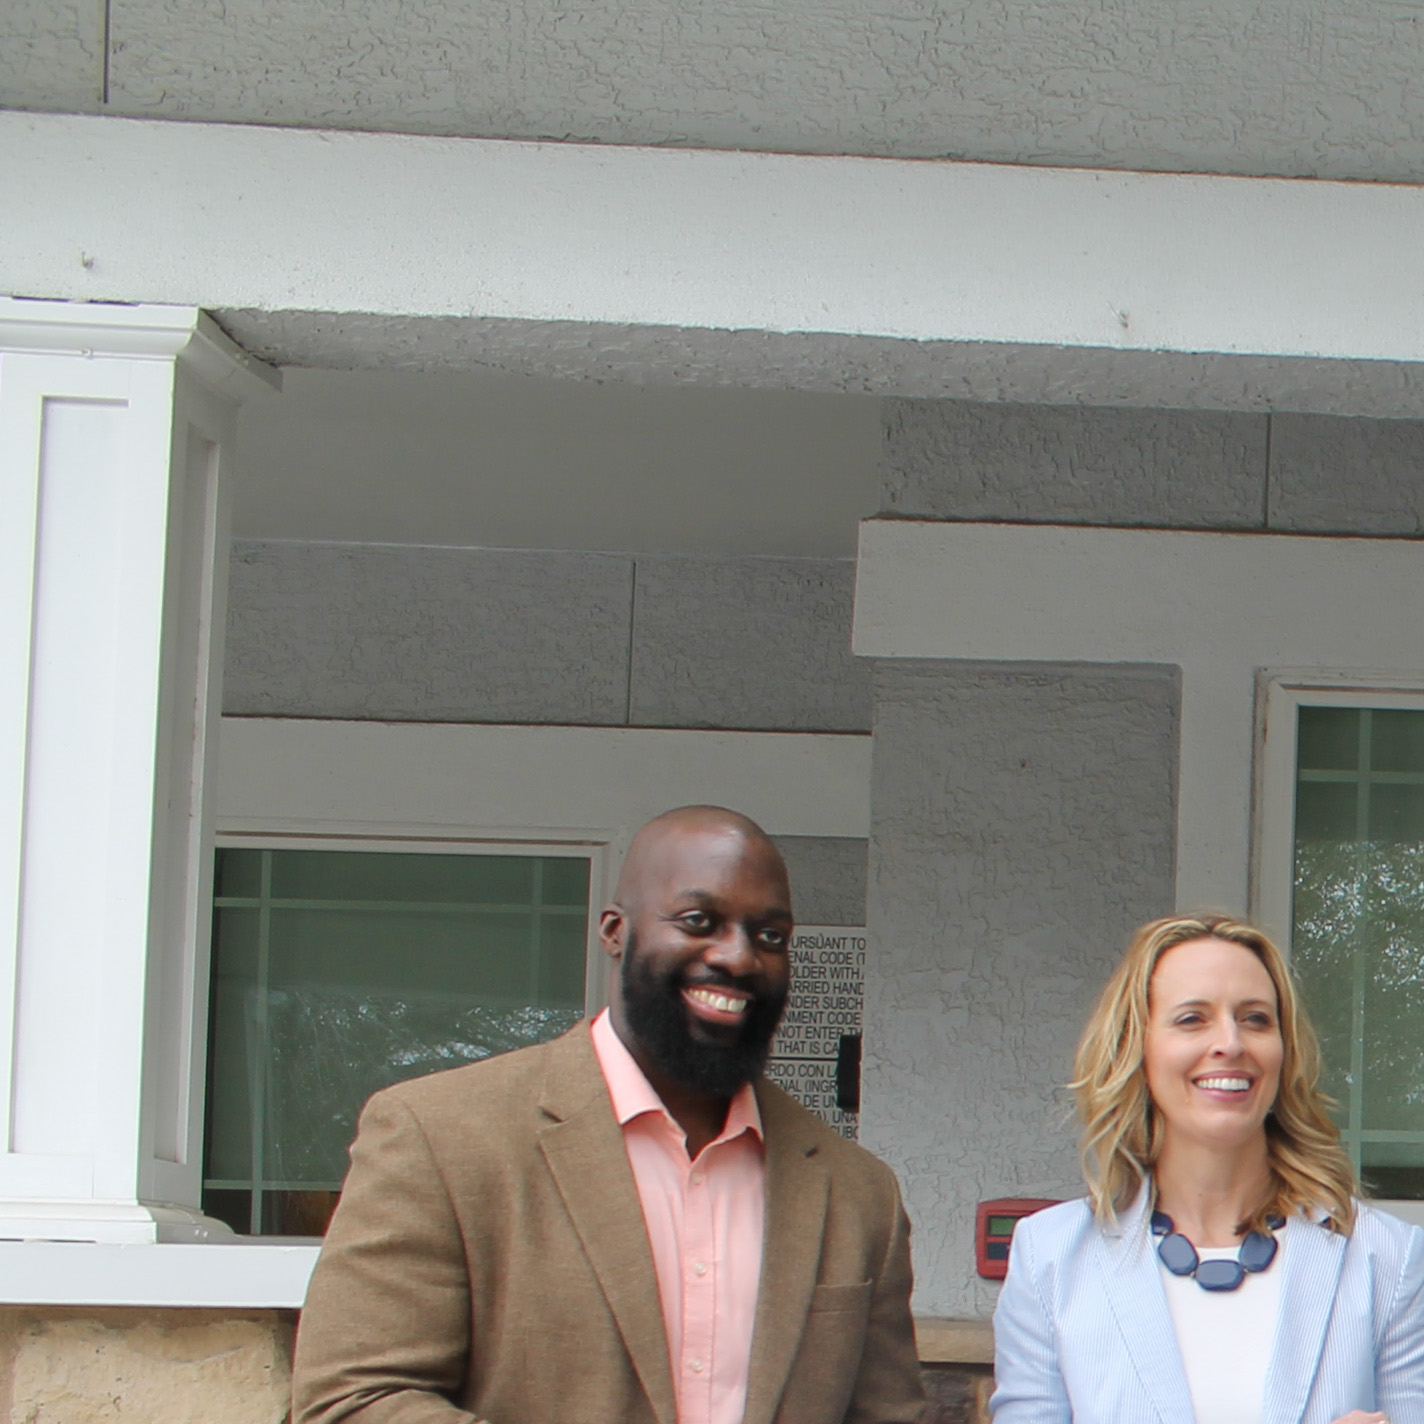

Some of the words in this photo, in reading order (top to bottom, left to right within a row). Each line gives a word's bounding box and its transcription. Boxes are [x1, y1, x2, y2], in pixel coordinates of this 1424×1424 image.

[790, 935, 848, 950] URSUANT
[850, 937, 866, 950] TO
[788, 950, 817, 964] ENAL
[820, 951, 853, 965] CODE
[790, 966, 827, 979] OLDER
[829, 967, 860, 980] WITH
[833, 982, 864, 996] HAND
[788, 995, 820, 1010] NDER
[822, 996, 864, 1010] SUBCH
[784, 1010, 825, 1024] NMENT
[828, 1011, 861, 1026] CODE
[777, 1025, 803, 1039] NOT
[805, 1026, 844, 1040] ENTER
[777, 1040, 807, 1054] THAT
[809, 1041, 820, 1055] IS
[798, 1064, 824, 1078] CON
[805, 1080, 837, 1094] (INGR
[803, 1095, 820, 1108] DE
[823, 1095, 837, 1108] UN
